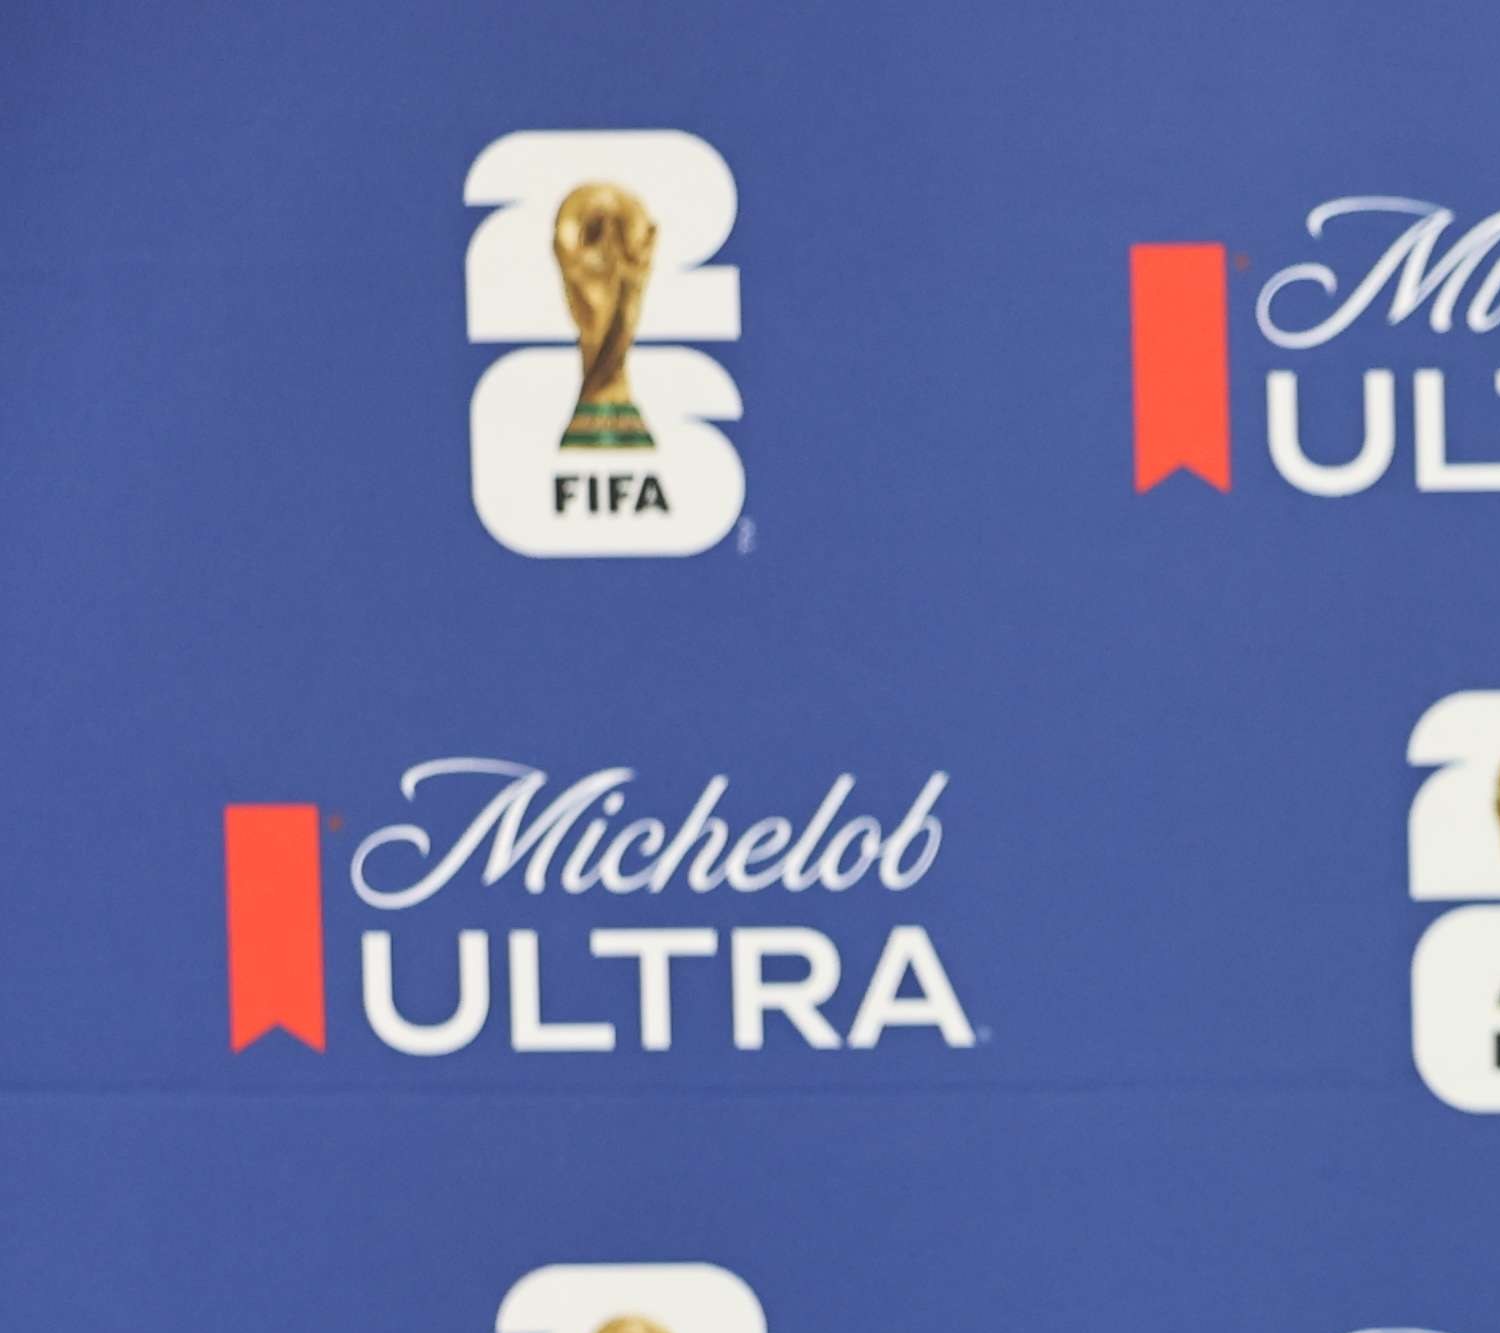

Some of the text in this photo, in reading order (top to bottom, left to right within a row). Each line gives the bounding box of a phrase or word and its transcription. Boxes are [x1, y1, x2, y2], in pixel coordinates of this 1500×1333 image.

[554, 475, 669, 513] FIFA
[351, 758, 948, 909] Michelob
[362, 926, 975, 1055] ULTRA
